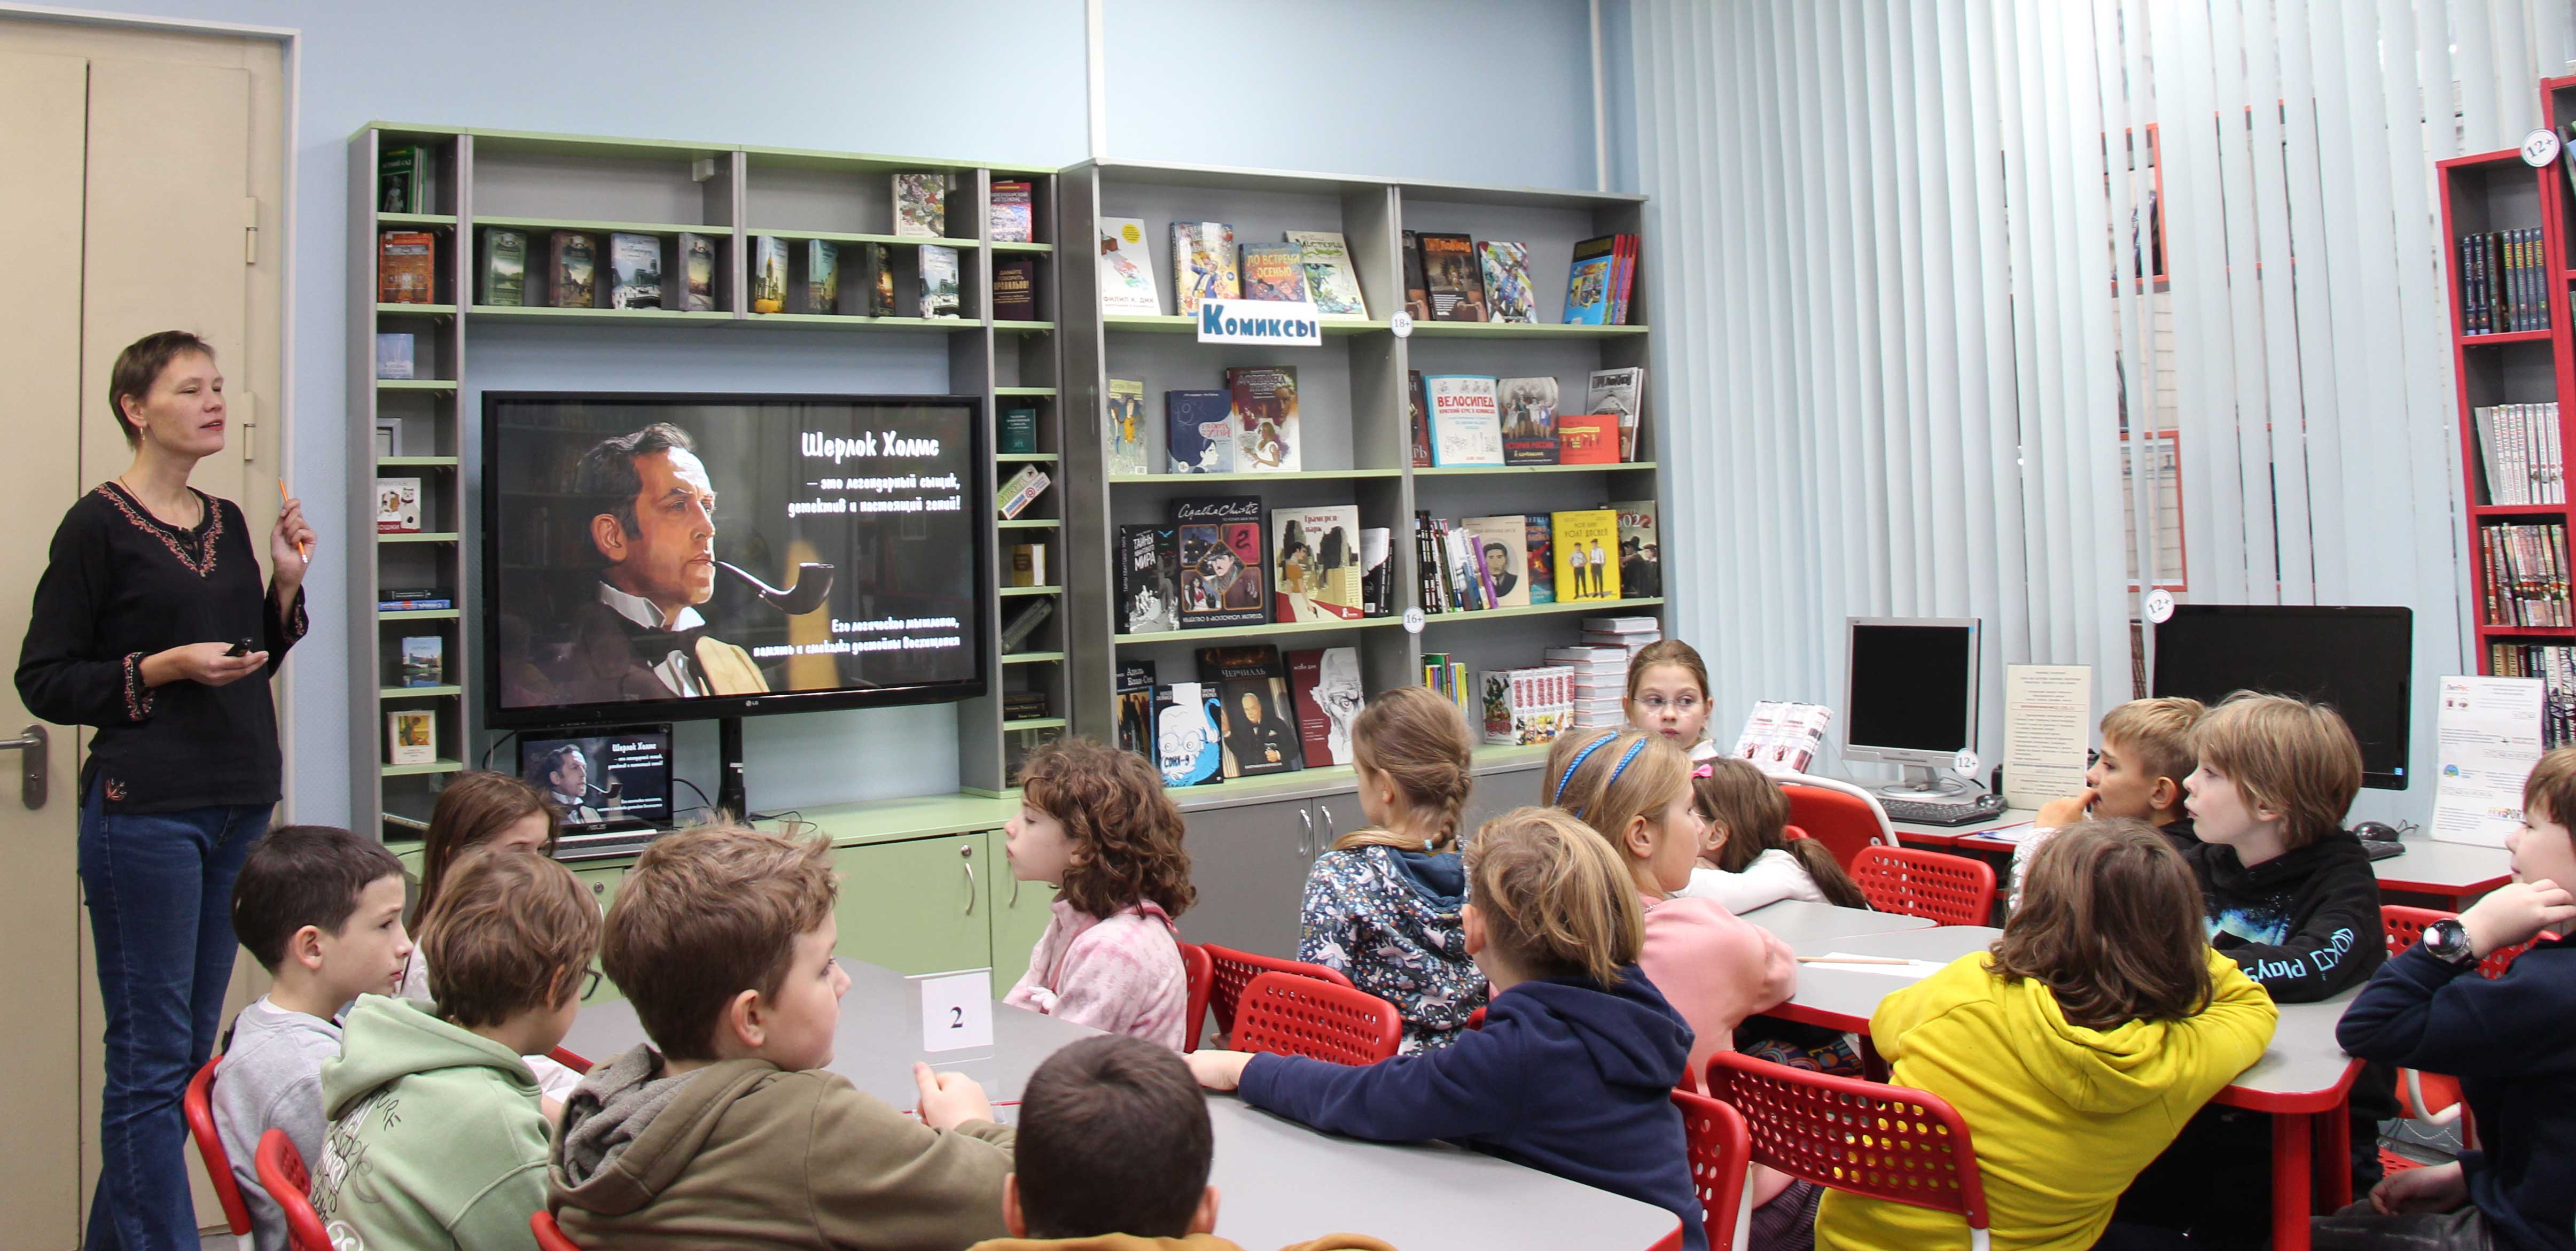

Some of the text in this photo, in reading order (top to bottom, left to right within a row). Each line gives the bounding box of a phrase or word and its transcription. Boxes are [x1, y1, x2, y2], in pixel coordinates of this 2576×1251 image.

[2525, 137, 2555, 159] 12+
[1262, 253, 1300, 266] ВСТРЕЧИ
[1257, 266, 1292, 278] ОСЕНЬЮ
[1394, 318, 1410, 328] 18+
[1437, 395, 1495, 407] ВЕЛОСИПЕД
[802, 430, 940, 464] Шерлок Холмс
[820, 477, 843, 490] это
[846, 473, 917, 493] легендарный
[919, 472, 961, 491] сыщик,
[787, 495, 961, 518] детектив и настоящий гений!
[1178, 502, 1259, 520] Agatha Christie
[1133, 533, 1154, 550] ТАЙНЫ
[1134, 551, 1156, 571] МИРА
[2148, 597, 2171, 614] 12+
[831, 616, 960, 633] Его логическое мышление,
[1406, 613, 1423, 624] 16+
[753, 644, 794, 658] память
[796, 646, 803, 655] и
[806, 638, 850, 655] смекалка
[851, 636, 901, 656] достойны
[1221, 668, 1267, 678] ЧЕРЧИЛЛЬ
[1957, 757, 1977, 768] 12+
[949, 1006, 964, 1029] 2
